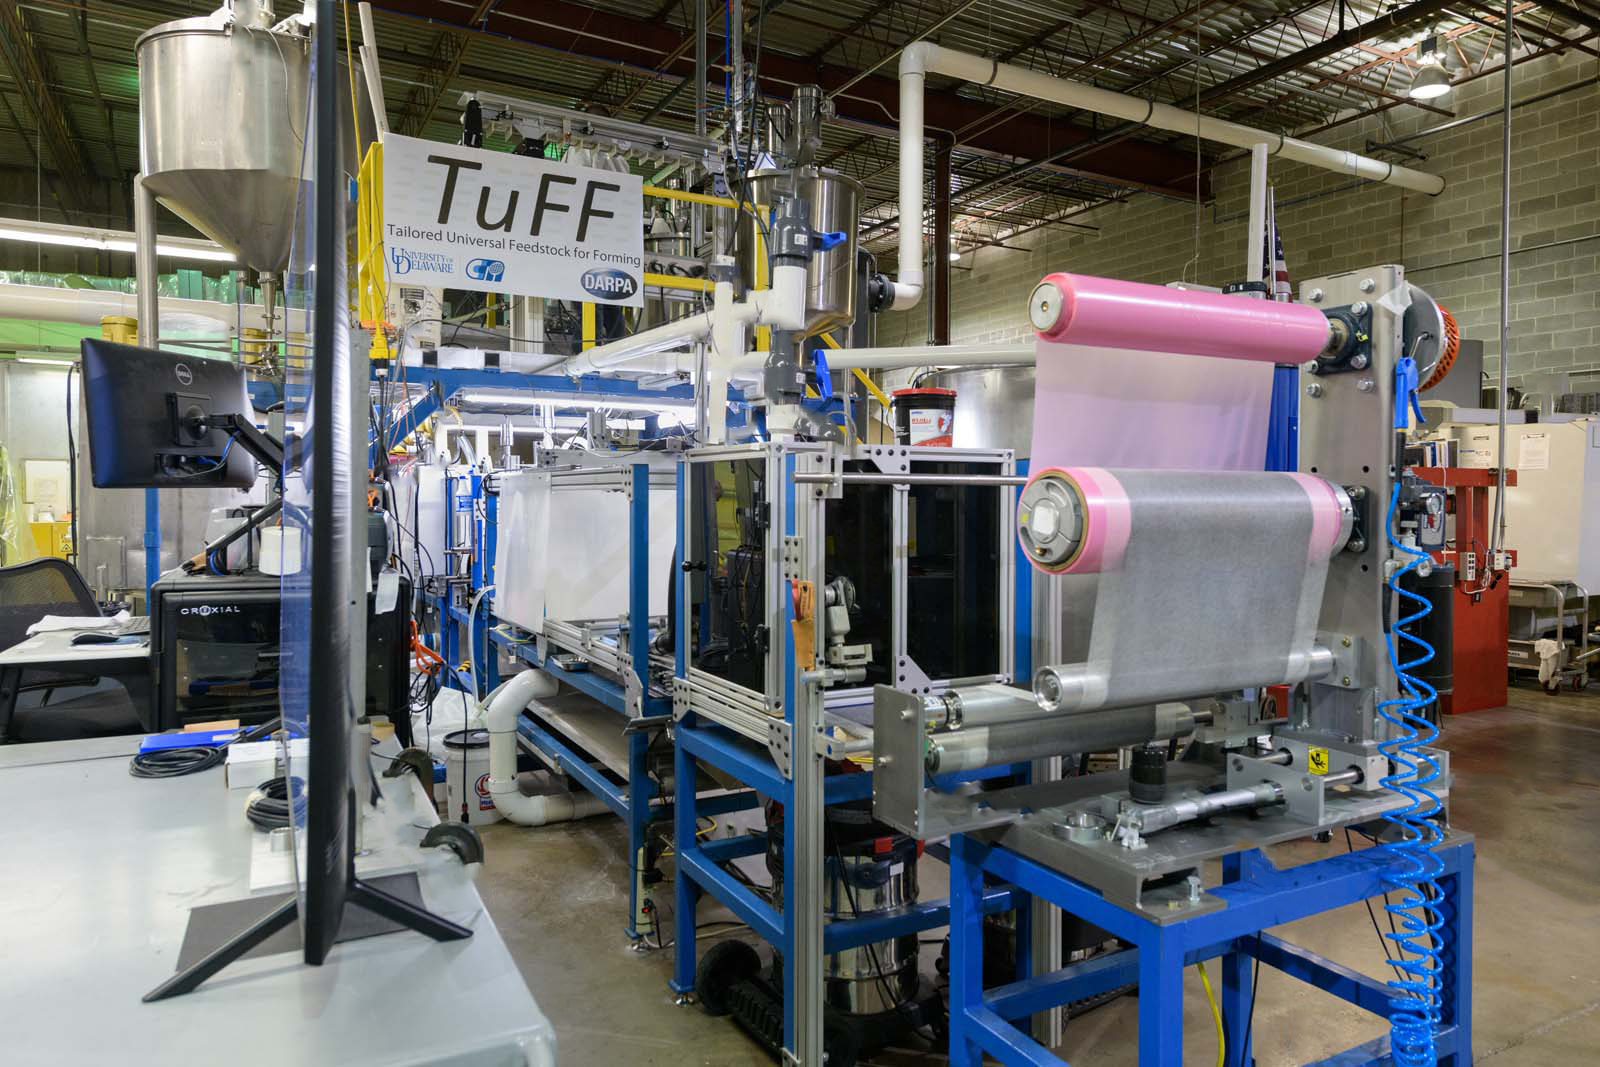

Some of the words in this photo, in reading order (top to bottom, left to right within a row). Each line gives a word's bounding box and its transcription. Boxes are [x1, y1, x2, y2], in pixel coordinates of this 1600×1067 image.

[428, 155, 621, 242] TuFF
[387, 224, 443, 241] Tailored
[447, 232, 505, 249] Universal
[509, 240, 571, 257] Feedstock
[574, 247, 590, 260] for
[593, 250, 641, 268] Forming
[395, 255, 454, 275] DELAWARE
[584, 274, 633, 294] DARPA
